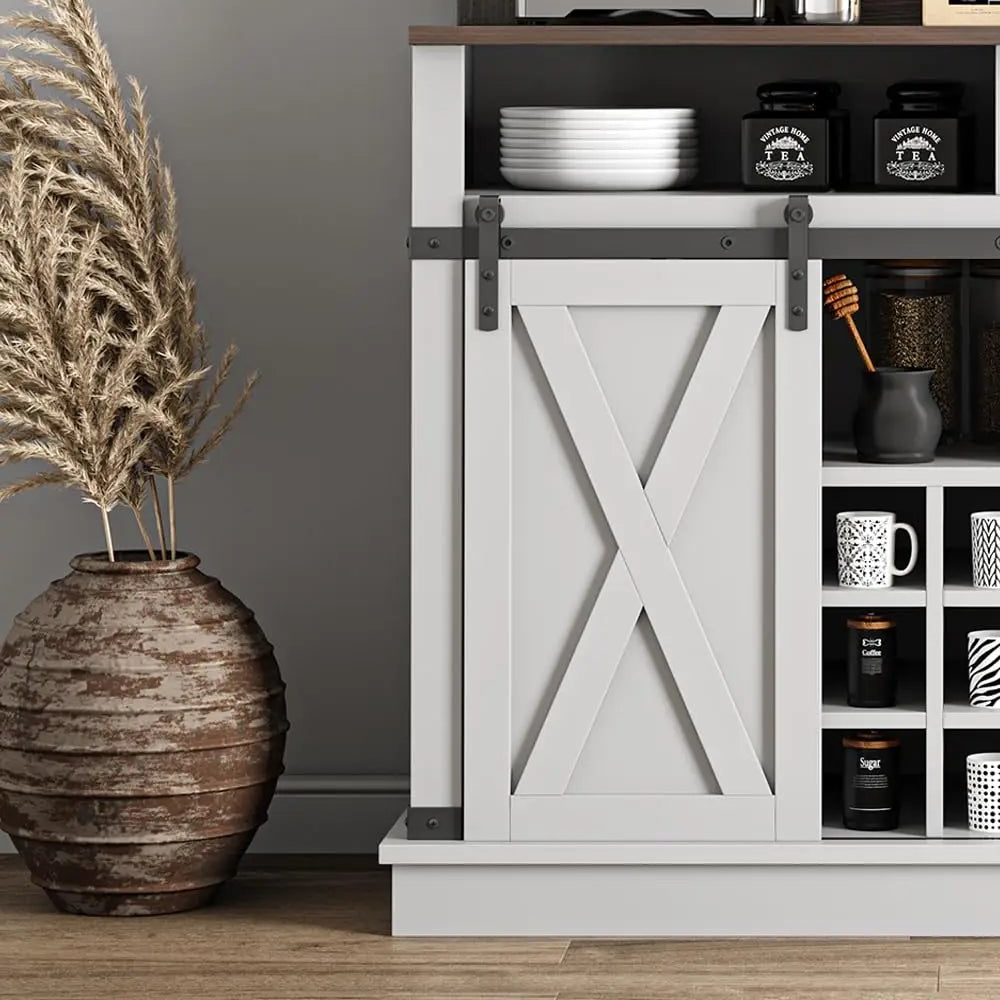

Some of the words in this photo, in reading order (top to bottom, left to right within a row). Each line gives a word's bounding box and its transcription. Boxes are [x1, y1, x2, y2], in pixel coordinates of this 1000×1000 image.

[760, 125, 790, 142] VINTAGE
[790, 127, 810, 144] HOME
[891, 125, 921, 142] VINTAGE
[921, 127, 941, 144] HOME
[764, 151, 805, 161] TEA
[895, 151, 936, 161] TEA
[860, 757, 881, 770] Sugar
